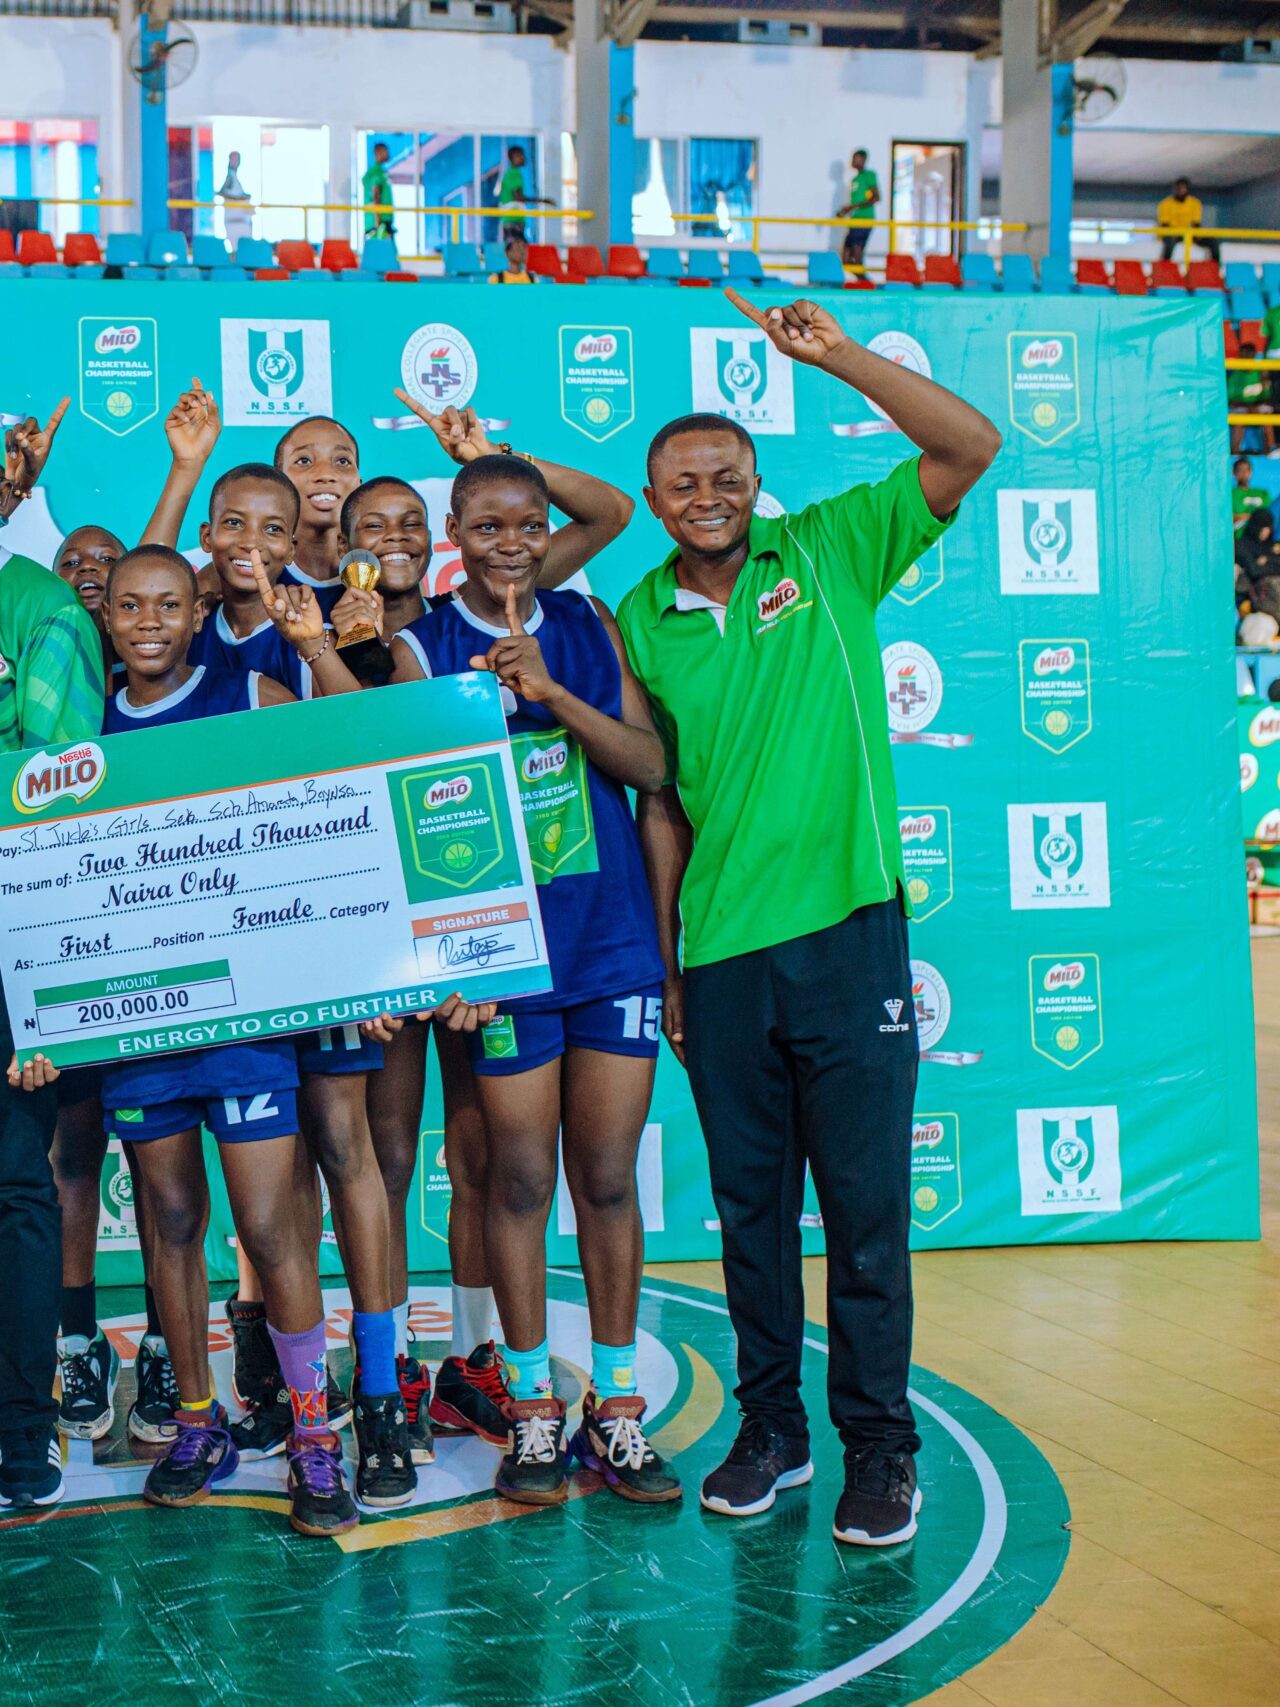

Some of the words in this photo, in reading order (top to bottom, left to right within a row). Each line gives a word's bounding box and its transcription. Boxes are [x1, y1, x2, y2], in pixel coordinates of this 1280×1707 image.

[101, 333, 136, 347] MILO
[580, 341, 614, 355] MILO
[1028, 347, 1059, 361] MILO
[85, 370, 153, 378] CHAMPIONSHIP
[88, 361, 148, 369] BASKETBALL
[568, 368, 625, 377] BASKETBALL
[760, 588, 797, 616] MILO
[1039, 655, 1071, 669] MILO
[58, 746, 93, 765] Nestlé
[528, 751, 566, 774] MILO
[25, 758, 98, 801] MILO
[430, 783, 468, 803] MILO
[521, 789, 579, 812] HAMPIONSHIP
[416, 816, 491, 835] CHAMPIONSHIP
[418, 808, 486, 826] BASKETBALL
[901, 823, 932, 836] MILO
[1, 882, 24, 896] The
[26, 878, 52, 893] sum
[53, 872, 73, 889] of:
[77, 853, 128, 878] Two
[134, 828, 244, 870] Hundred
[251, 806, 372, 848] Thousand
[102, 882, 173, 910] Naira
[181, 866, 240, 897] Only
[431, 909, 511, 932] SIGNATURE
[14, 959, 35, 972] As:
[59, 932, 113, 959] First
[152, 930, 205, 949] Position
[231, 898, 314, 931] Female
[329, 900, 390, 920] Category
[105, 974, 159, 993] AMOUNT
[1049, 968, 1082, 984] MILO
[77, 989, 190, 1024] 200,000.00
[1035, 1003, 1097, 1014] CHAMPIONSHIP
[1038, 995, 1093, 1005] BASKETBALL
[118, 1024, 219, 1054] ENERGY
[225, 1017, 265, 1036] TO
[269, 1010, 310, 1027] GO
[318, 989, 438, 1022] FURTHER
[613, 995, 663, 1042] 15
